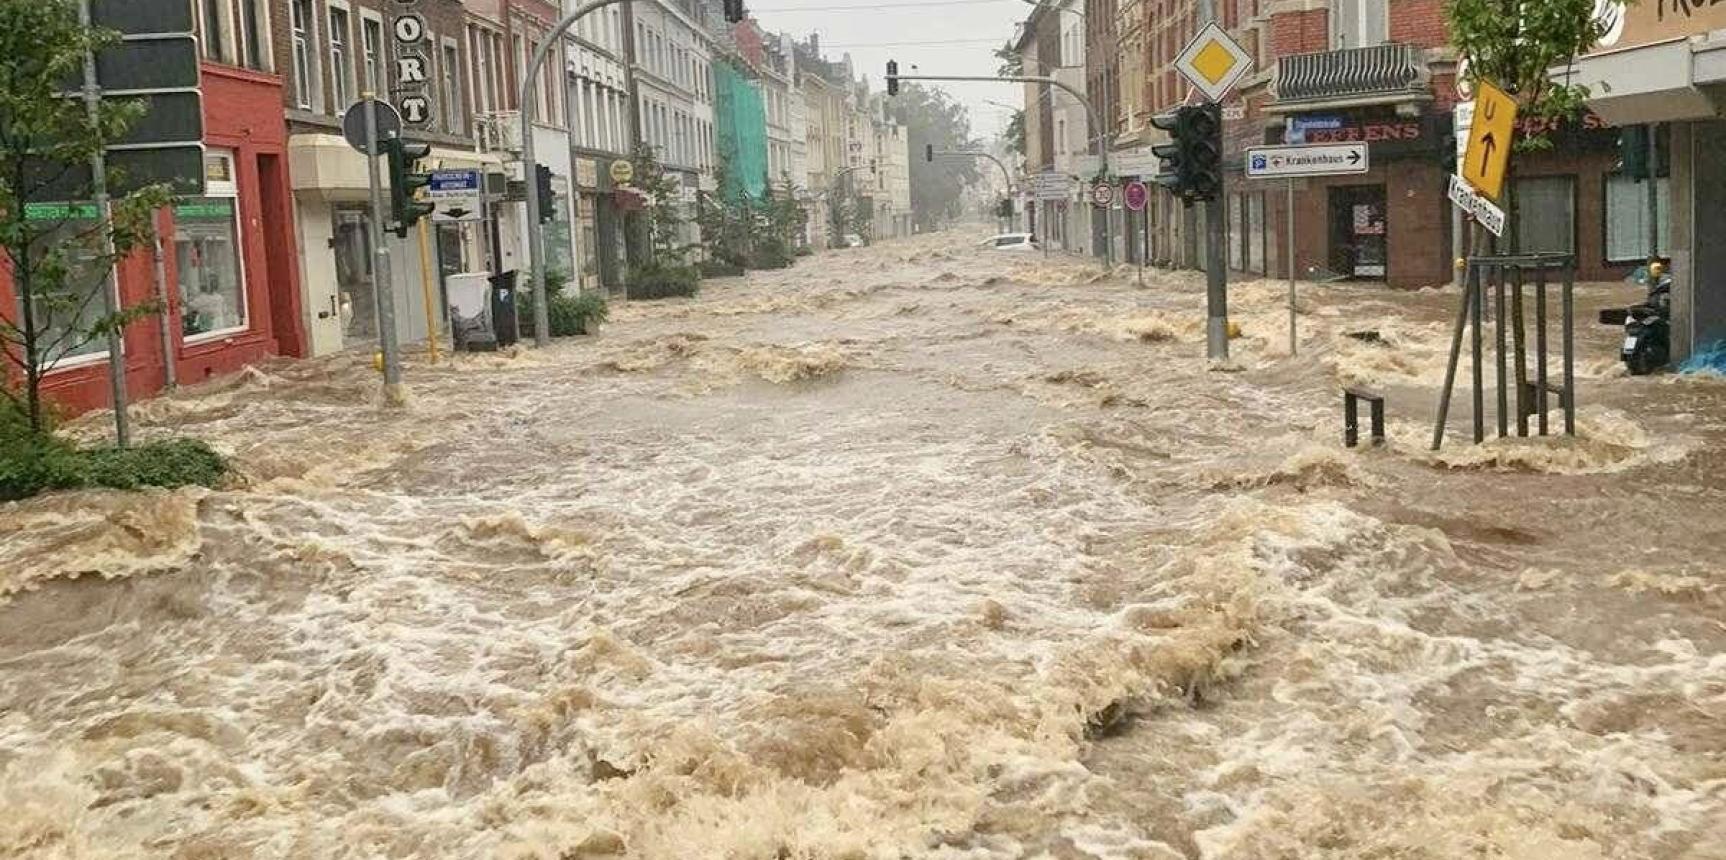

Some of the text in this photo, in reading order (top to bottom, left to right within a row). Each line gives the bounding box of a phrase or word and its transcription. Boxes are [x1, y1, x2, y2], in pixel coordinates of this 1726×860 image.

[395, 0, 427, 122] ORT
[1485, 98, 1497, 120] U
[1285, 154, 1343, 166] Krankenhaus
[1451, 180, 1502, 236] Krankenhaus
